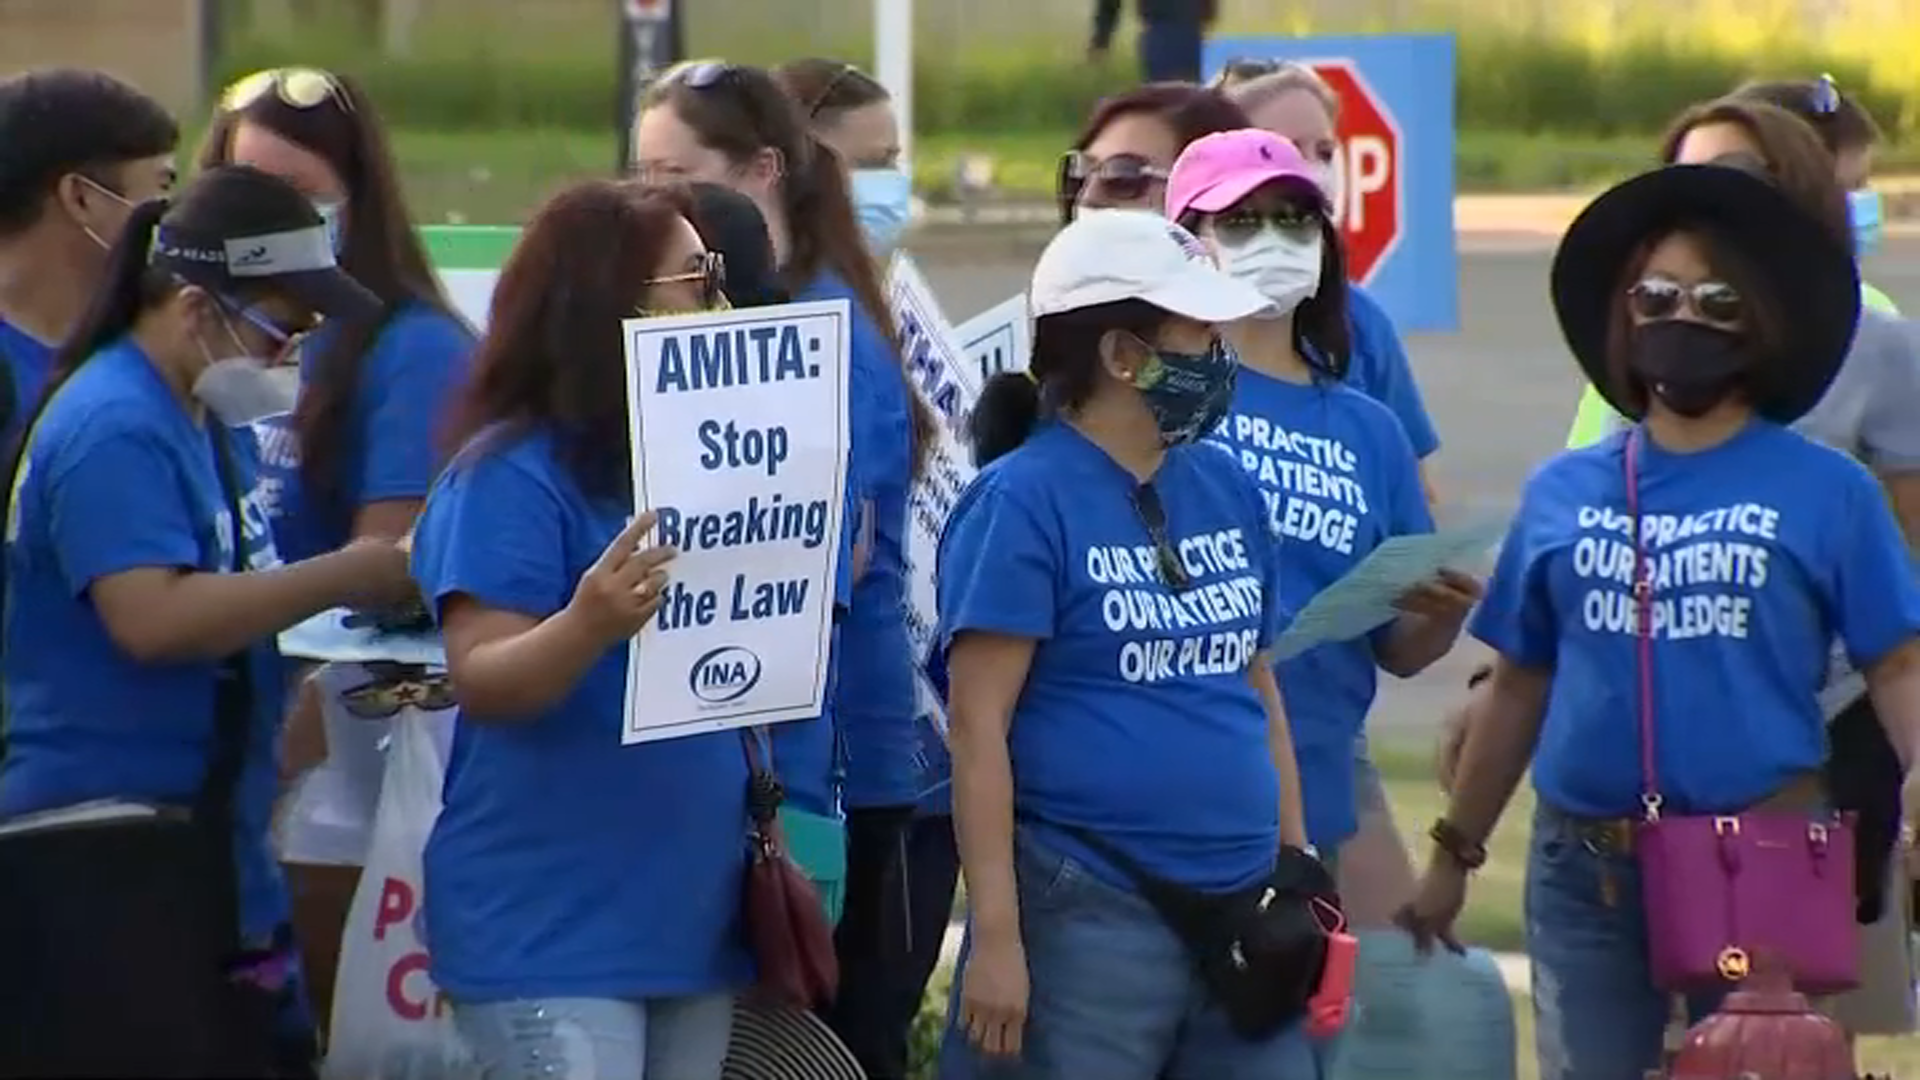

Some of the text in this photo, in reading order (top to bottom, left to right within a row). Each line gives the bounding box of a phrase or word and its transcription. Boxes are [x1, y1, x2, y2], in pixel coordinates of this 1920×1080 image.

[656, 325, 820, 394] AMITA:
[699, 419, 787, 475] Stop
[1235, 414, 1357, 473] PRACTIC
[657, 494, 828, 553] Breaking
[1258, 487, 1358, 556] LEDGE
[1640, 502, 1780, 548] PRACTICE
[1087, 528, 1249, 584] OUR PCTICE
[1573, 537, 1769, 590] OUR PATIENTS
[657, 574, 810, 631] the Law
[1103, 588, 1162, 632] OUR
[1583, 589, 1751, 639] OUR PLEDGE
[703, 661, 747, 685] INA
[1120, 629, 1259, 683] OUR PLEDG
